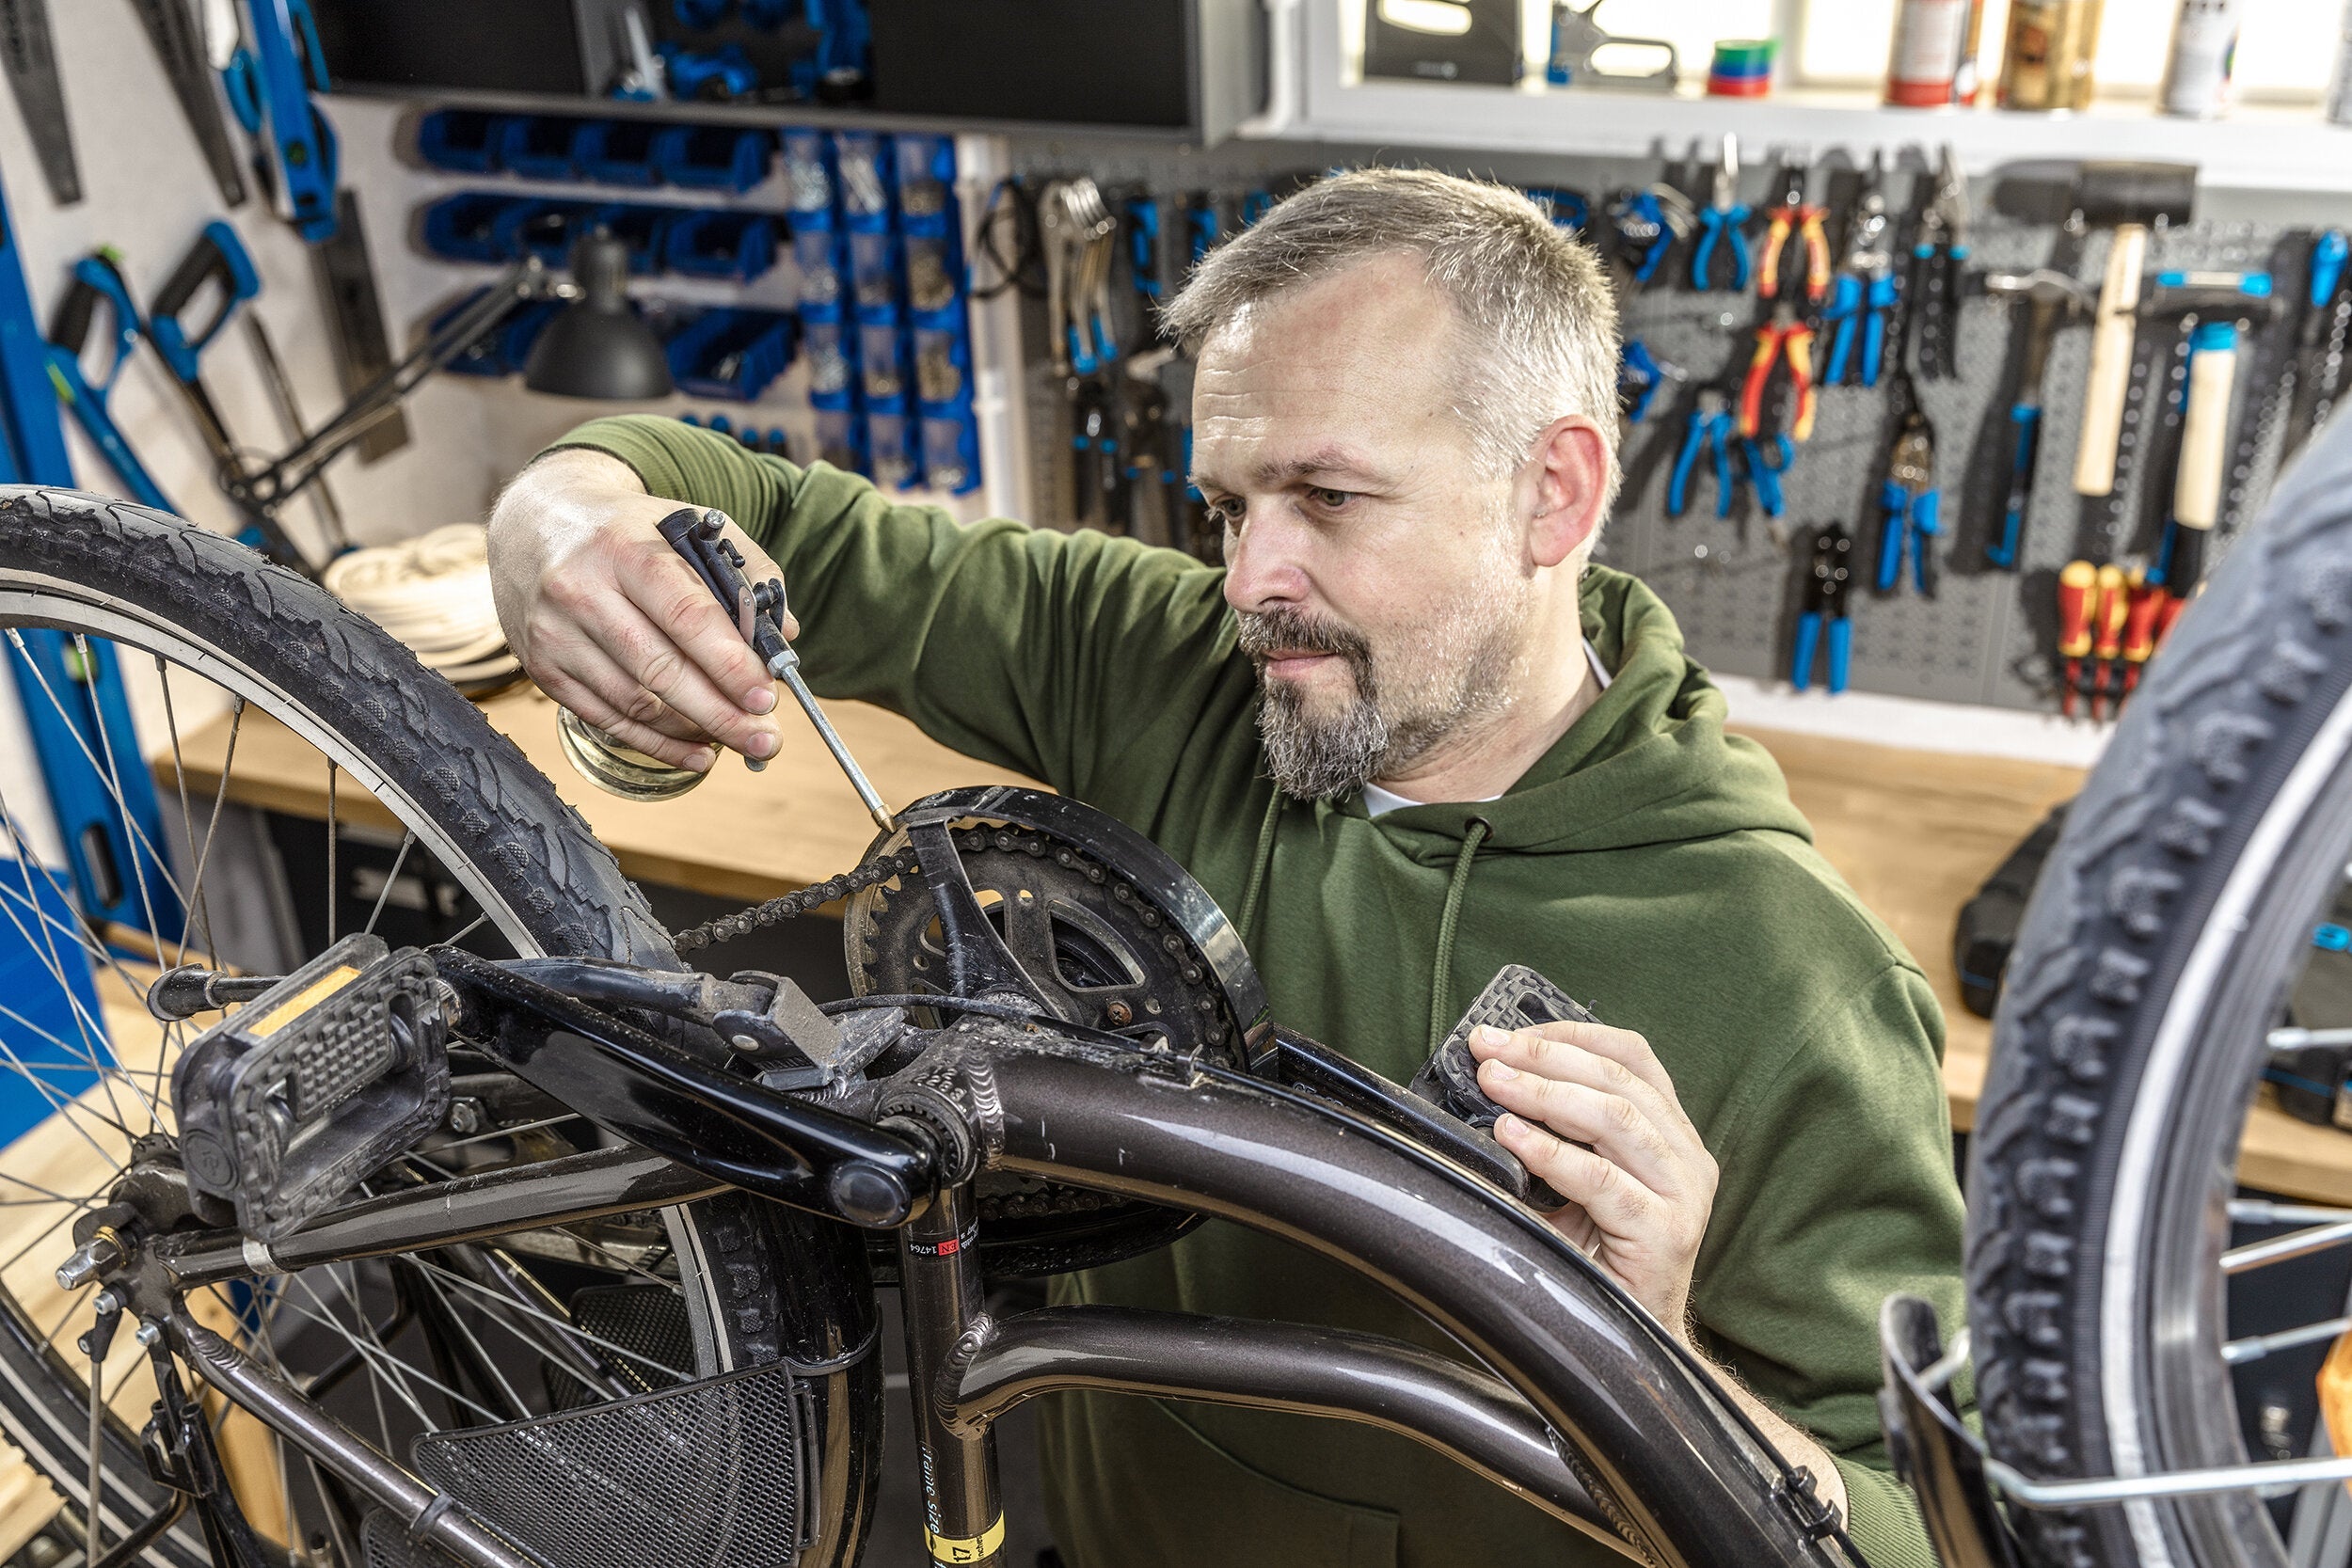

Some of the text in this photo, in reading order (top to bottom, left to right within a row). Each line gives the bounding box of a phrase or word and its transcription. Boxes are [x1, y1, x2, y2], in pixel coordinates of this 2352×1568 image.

[910, 1243, 938, 1255] 14764
[940, 1241, 957, 1254] EN
[927, 1499, 943, 1535] size
